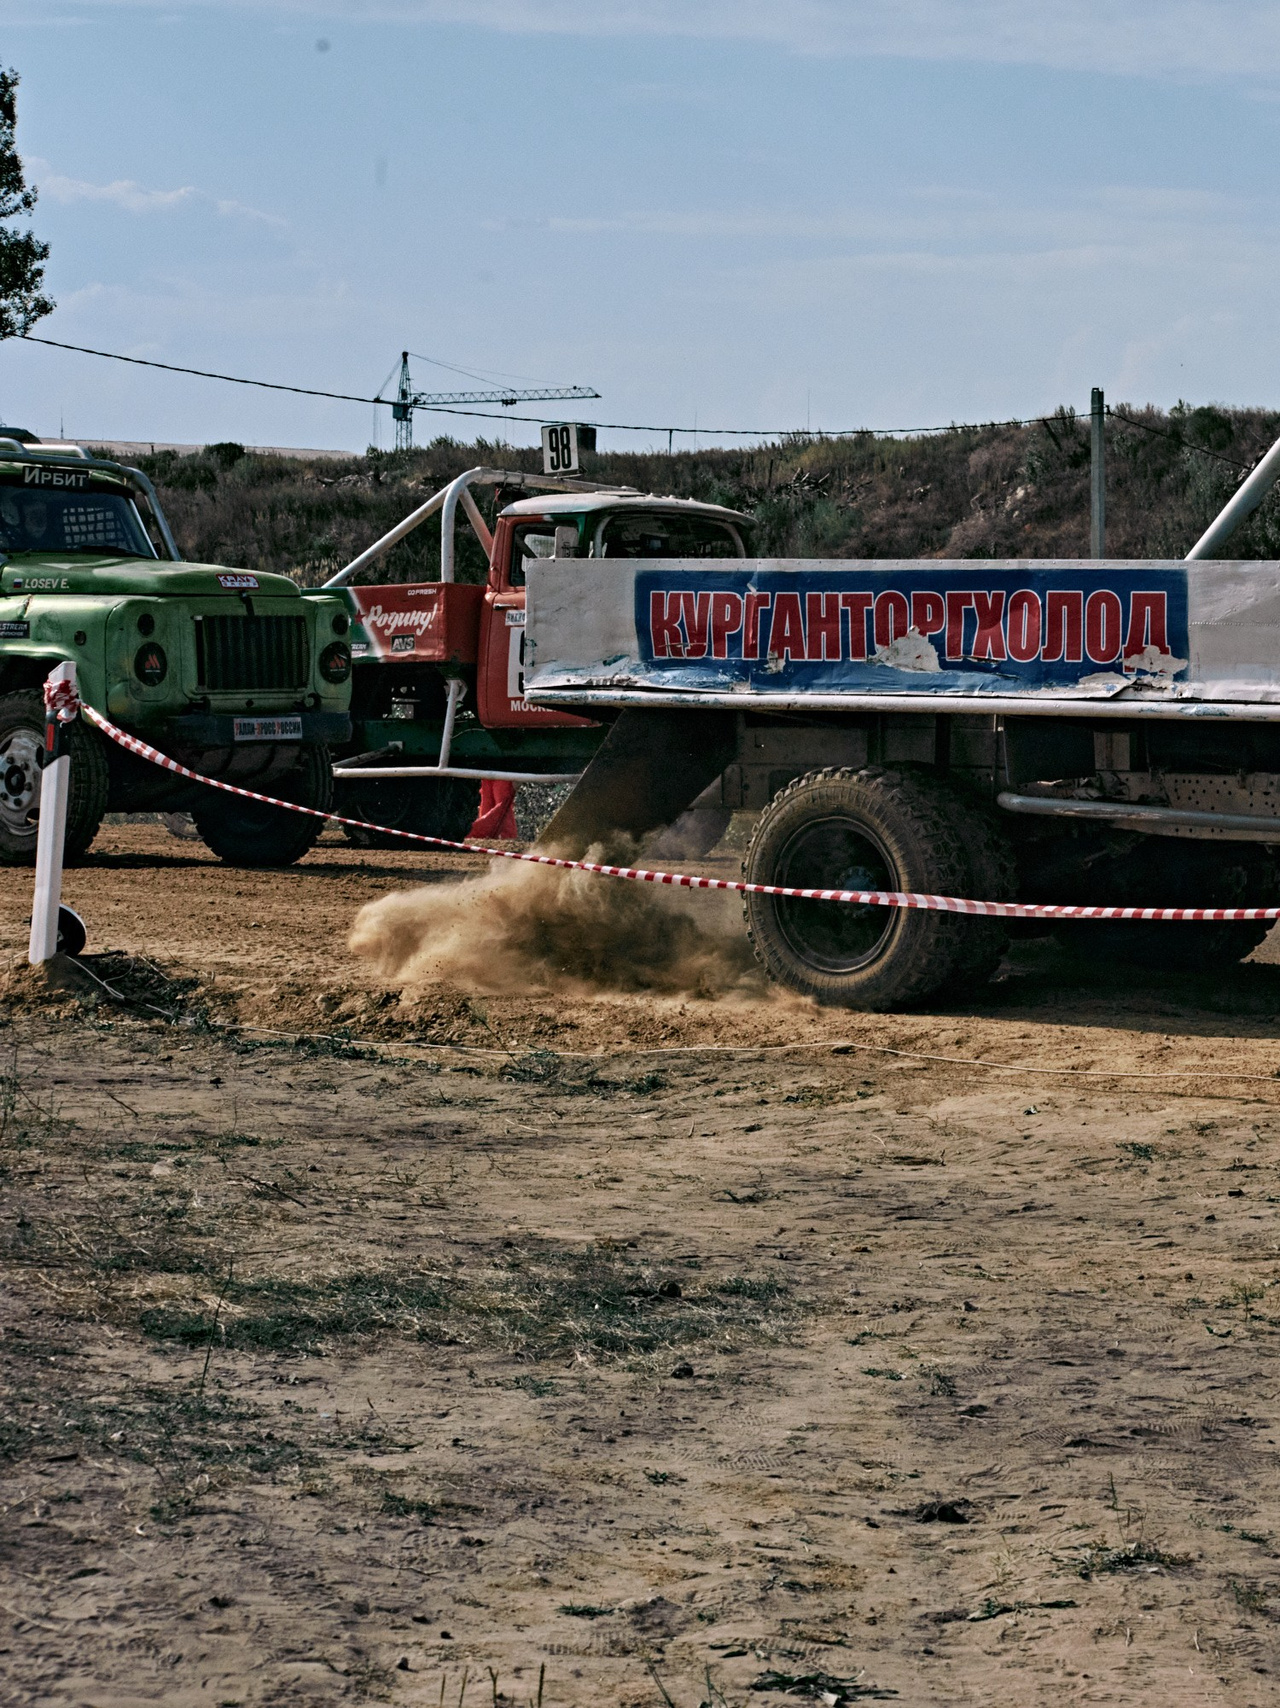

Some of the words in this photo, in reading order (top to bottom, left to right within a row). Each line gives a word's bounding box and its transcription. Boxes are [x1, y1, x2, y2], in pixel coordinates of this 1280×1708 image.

[549, 426, 572, 471] 98
[24, 578, 59, 589] LOSEV
[60, 578, 70, 589] E.
[362, 602, 438, 637] Родину!
[649, 589, 1172, 674] КУРГАНТОРГХОЛОД
[392, 637, 415, 650] AVS
